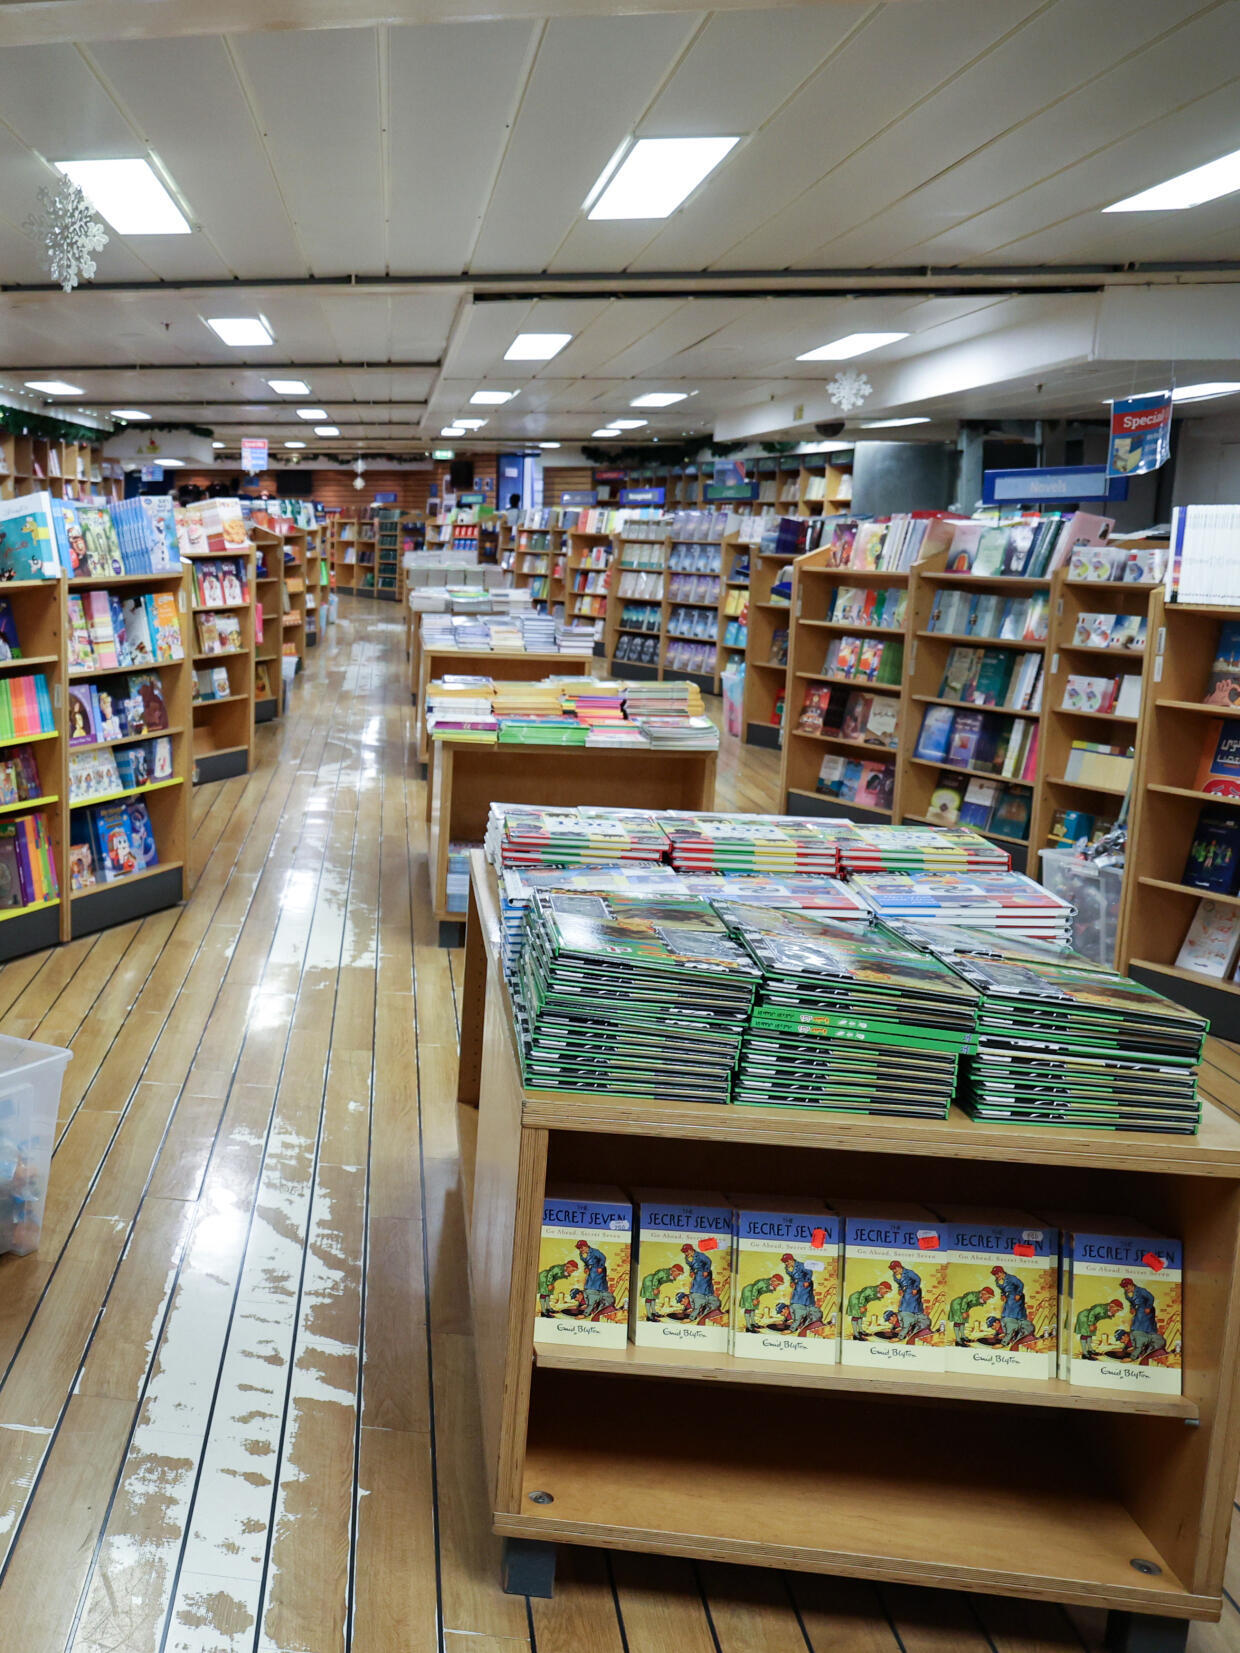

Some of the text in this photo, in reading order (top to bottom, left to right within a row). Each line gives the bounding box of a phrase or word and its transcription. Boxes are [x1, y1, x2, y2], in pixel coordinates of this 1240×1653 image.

[542, 1208, 627, 1225] SECRET SEVEN
[647, 1212, 731, 1230] SECRET SEVEN
[747, 1221, 791, 1237] SECRET
[853, 1228, 899, 1244] SECRET
[954, 1232, 1000, 1249] SECRET
[1081, 1243, 1130, 1262] SECRET
